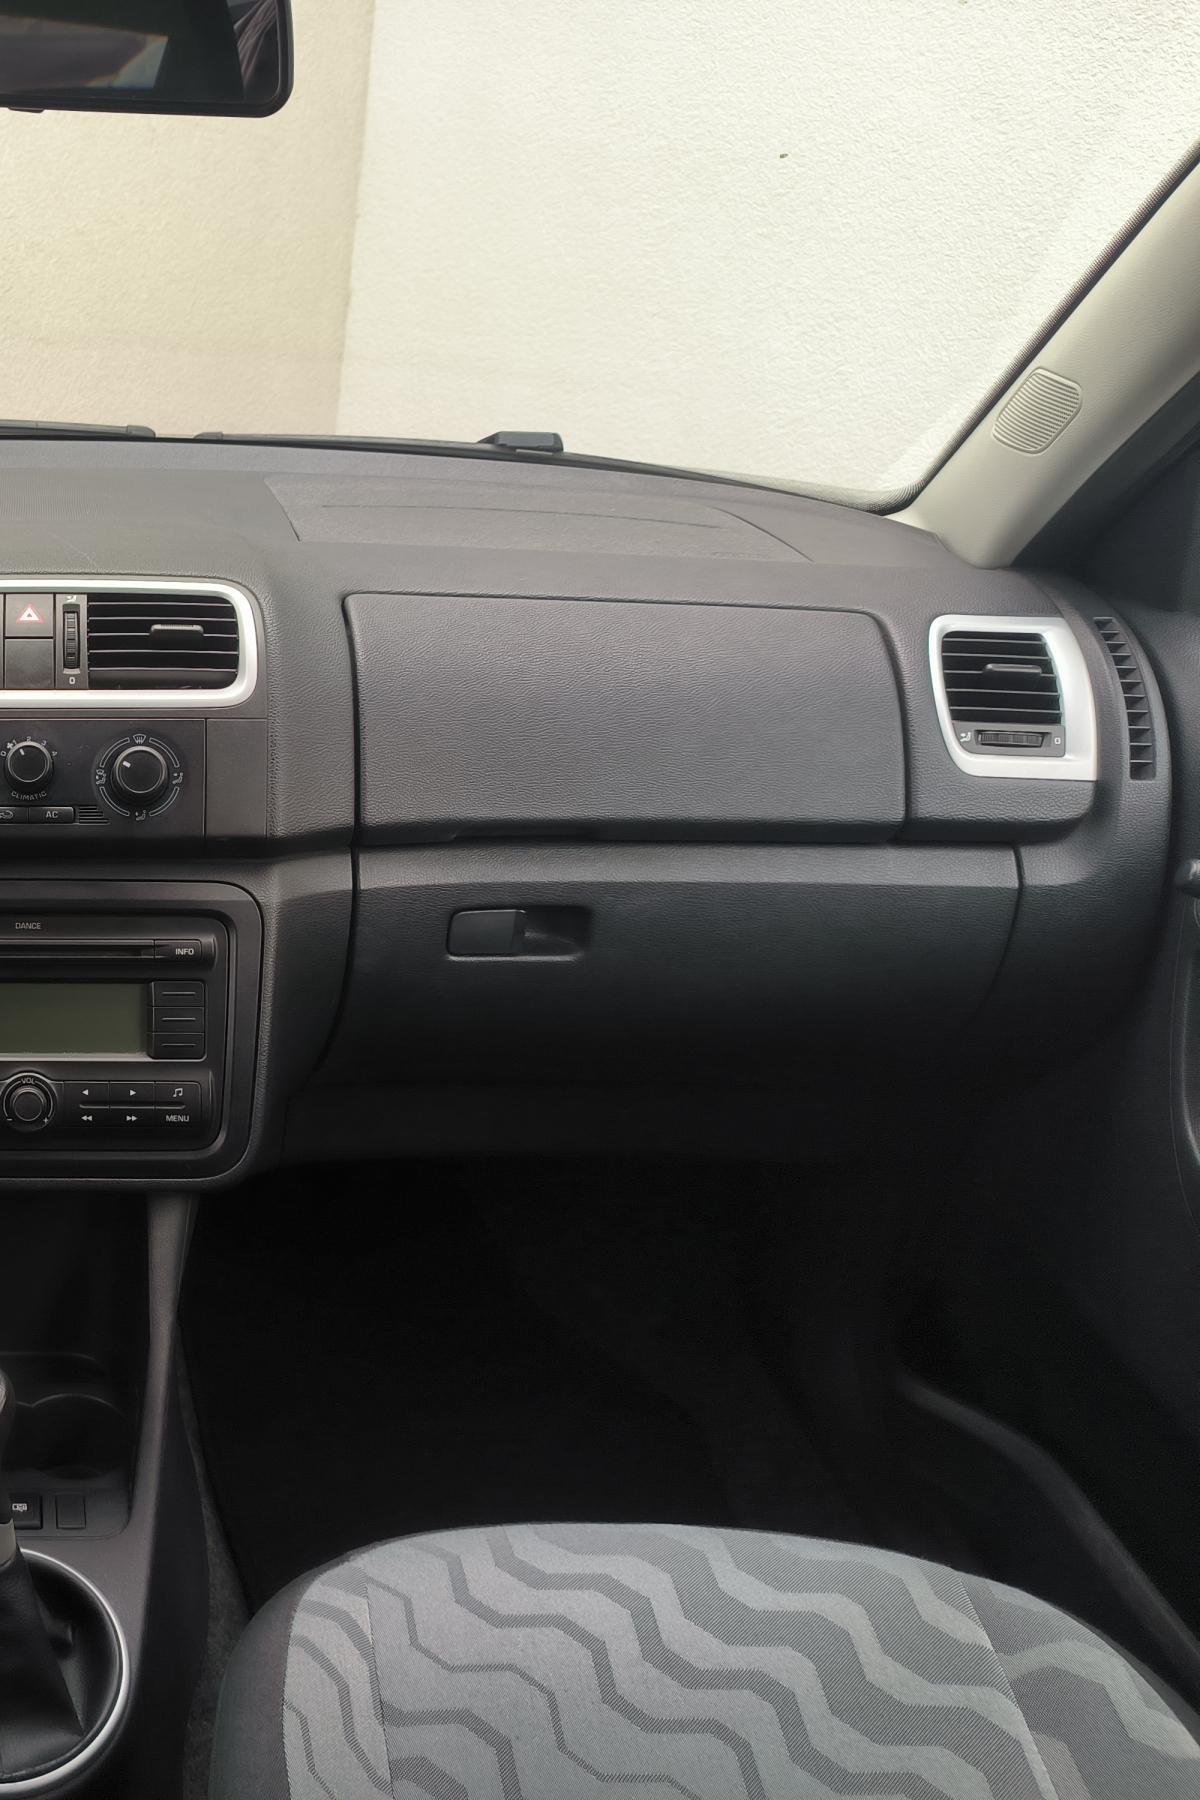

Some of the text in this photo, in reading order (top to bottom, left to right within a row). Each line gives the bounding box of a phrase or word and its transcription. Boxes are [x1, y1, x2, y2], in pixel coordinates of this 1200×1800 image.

[11, 790, 47, 801] CLIMATIC
[45, 810, 59, 819] AC
[15, 922, 42, 930] DANCE
[175, 948, 195, 956] INFO
[21, 1077, 36, 1085] VOL
[165, 1114, 190, 1122] MENU
